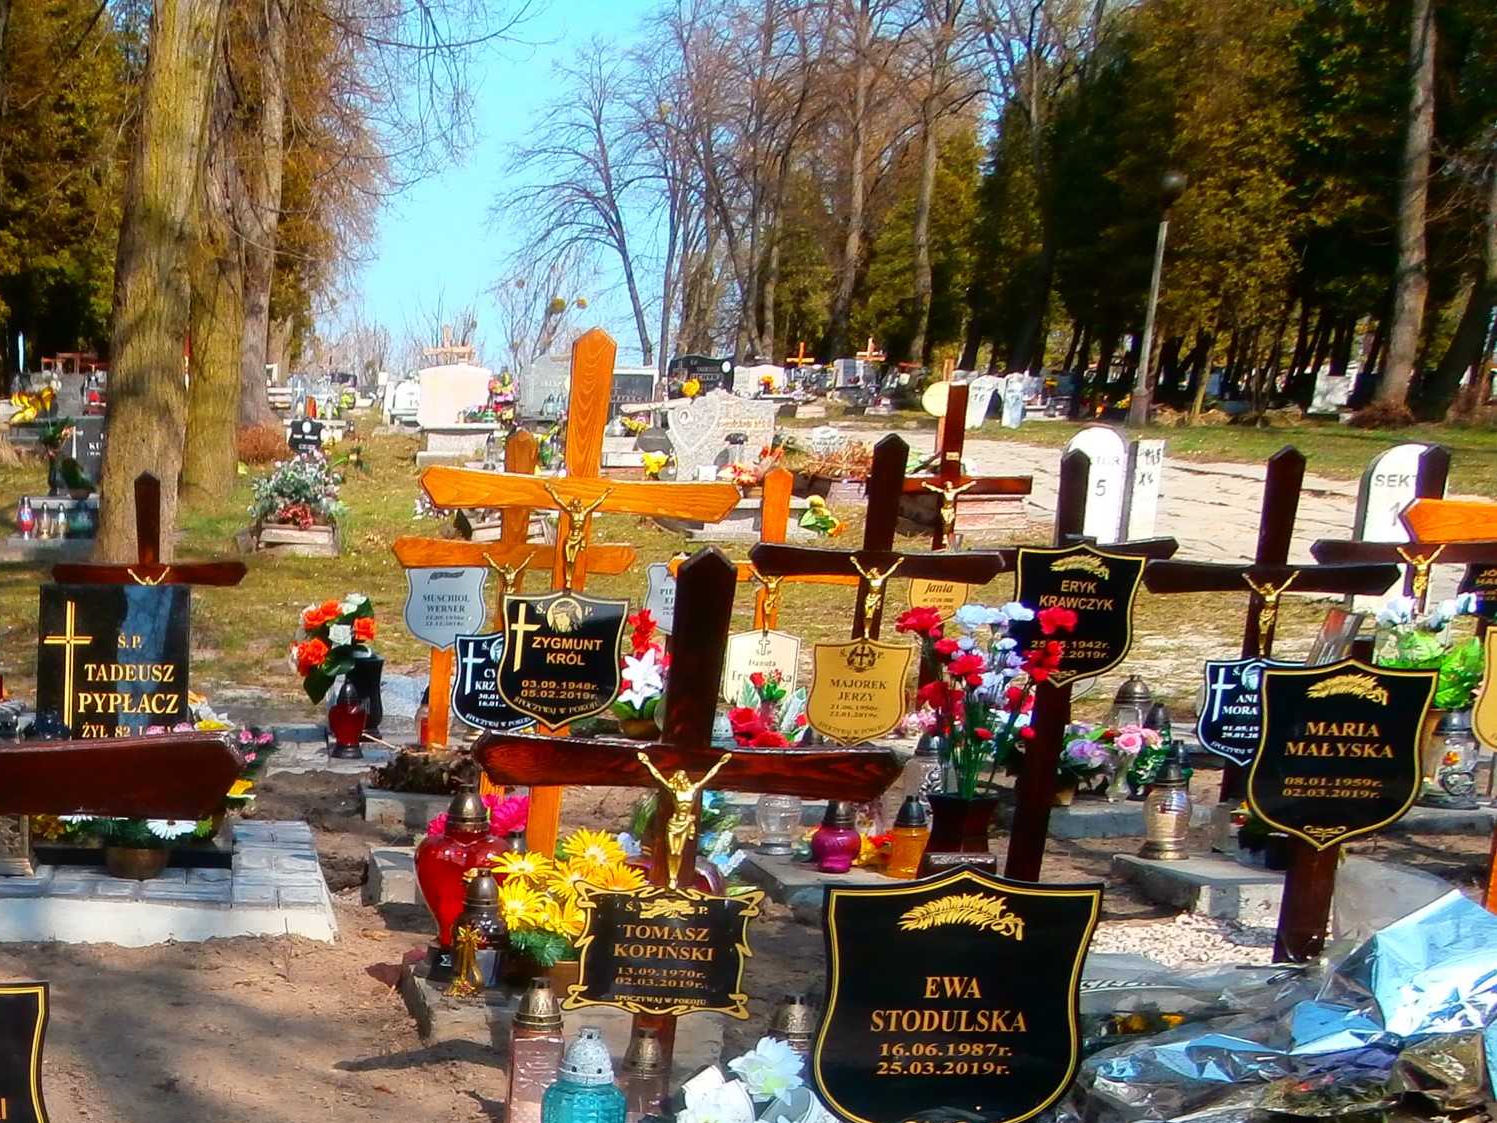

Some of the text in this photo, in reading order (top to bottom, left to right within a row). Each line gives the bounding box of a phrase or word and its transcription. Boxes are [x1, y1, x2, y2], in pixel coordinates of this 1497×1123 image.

[1374, 474, 1417, 487] SEK
[1095, 479, 1106, 496] 5
[1480, 568, 1497, 577] JÓ
[1061, 580, 1097, 594] ERYK
[426, 604, 465, 613] WERNER
[1039, 595, 1114, 611] KRAWCZYK
[584, 605, 593, 616] P.
[532, 636, 603, 651] ZYGMUNT
[1030, 640, 1111, 649] 255.1942r.
[546, 650, 586, 666] KRÓL
[1058, 651, 1110, 659] 2.2019r.
[84, 663, 175, 683] TADEUSZ
[474, 680, 495, 691] KRZ
[521, 680, 599, 691] 03.09.1948r.
[830, 678, 888, 690] MAJOREK
[520, 690, 599, 700] 05.02.2019r.
[838, 691, 875, 702] JERZY
[1236, 694, 1259, 703] ANI
[78, 692, 179, 714] PYPŁACZ
[559, 706, 567, 714] W
[1222, 705, 1258, 715] MORA
[82, 721, 108, 739] ŻYŁ
[114, 726, 131, 738] 82
[1304, 721, 1379, 737] MARIA
[1284, 741, 1396, 759] MAŁYSKA
[1284, 776, 1384, 788] 08.01.1959r.
[1282, 787, 1382, 799] 02.03.2019r.
[625, 900, 708, 915] Ś. P.
[621, 924, 710, 942] TOMASZ
[613, 942, 714, 962] KOPIŃSKI
[617, 966, 706, 979] 13.09.1970r.
[614, 977, 705, 990] 02.03.2019r.
[923, 976, 982, 999] EWA
[614, 994, 662, 1004] SPOCZYWAJ
[673, 998, 707, 1006] POKOJU
[870, 1009, 1027, 1033] STODULSKA
[879, 1043, 1013, 1058] 16.06.1987r.
[876, 1061, 1010, 1076] 25.03.2019r.
